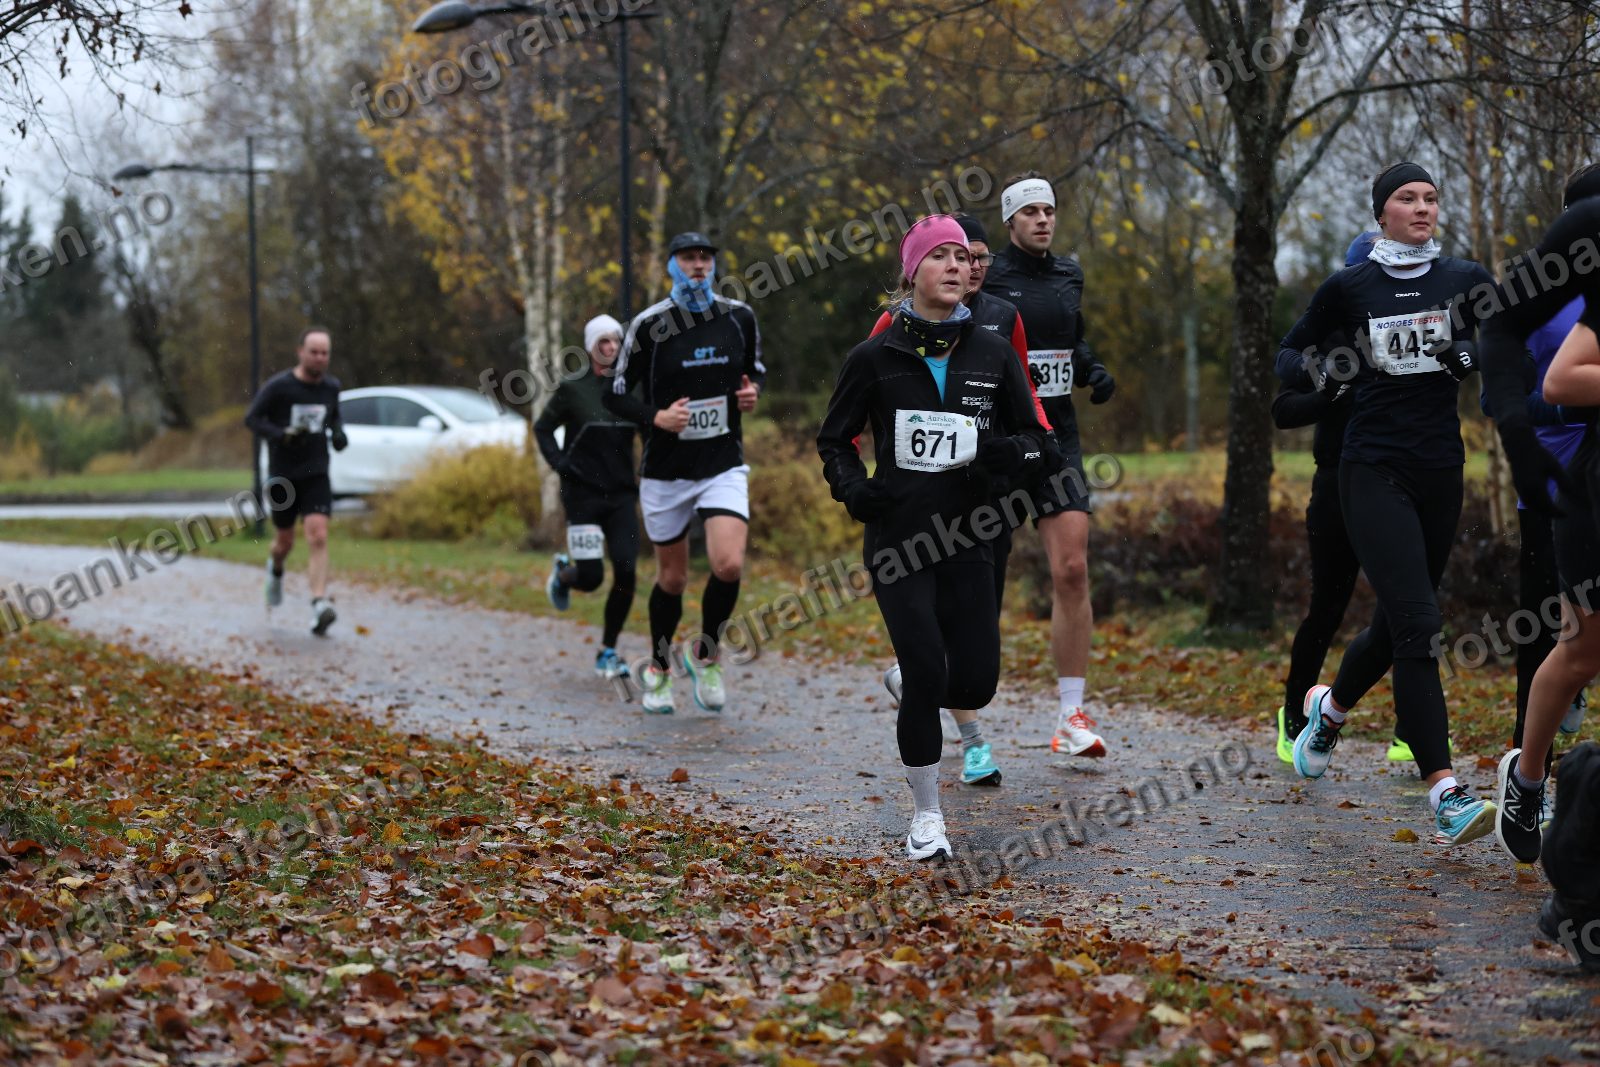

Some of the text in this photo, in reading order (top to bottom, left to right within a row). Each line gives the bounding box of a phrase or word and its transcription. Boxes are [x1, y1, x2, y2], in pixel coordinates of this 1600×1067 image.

[1376, 314, 1445, 331] NORGESTESTEN
[1388, 329, 1440, 360] 445
[688, 408, 719, 431] 402
[911, 428, 958, 460] 671
